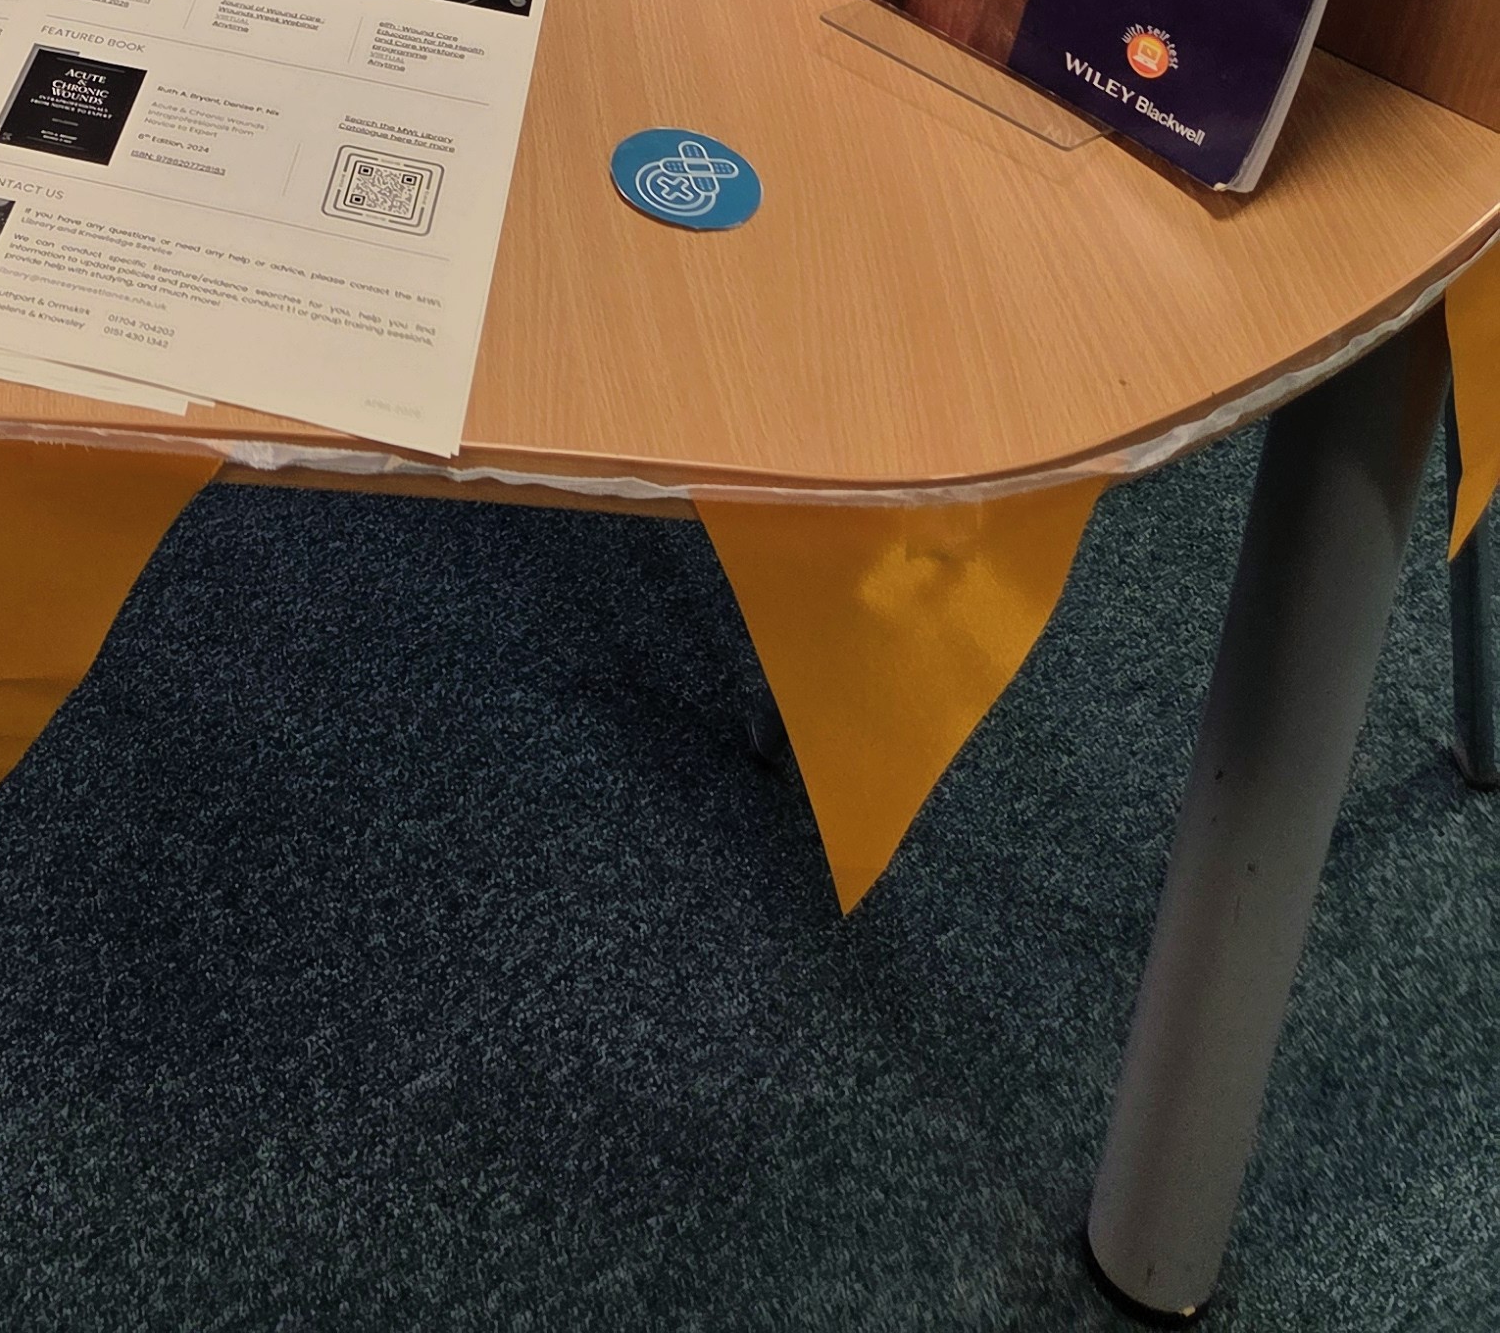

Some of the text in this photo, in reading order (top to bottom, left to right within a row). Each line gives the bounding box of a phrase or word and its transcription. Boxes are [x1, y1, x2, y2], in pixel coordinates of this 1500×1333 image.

[40, 23, 146, 55] FEATURED BOOK
[1121, 23, 1179, 70] with self-test
[64, 67, 106, 85] ACUTE
[50, 85, 104, 107] WOUNDS
[52, 78, 110, 100] CHRONIC
[1065, 51, 1205, 146] WILEY Blackwell
[44, 187, 64, 201] US
